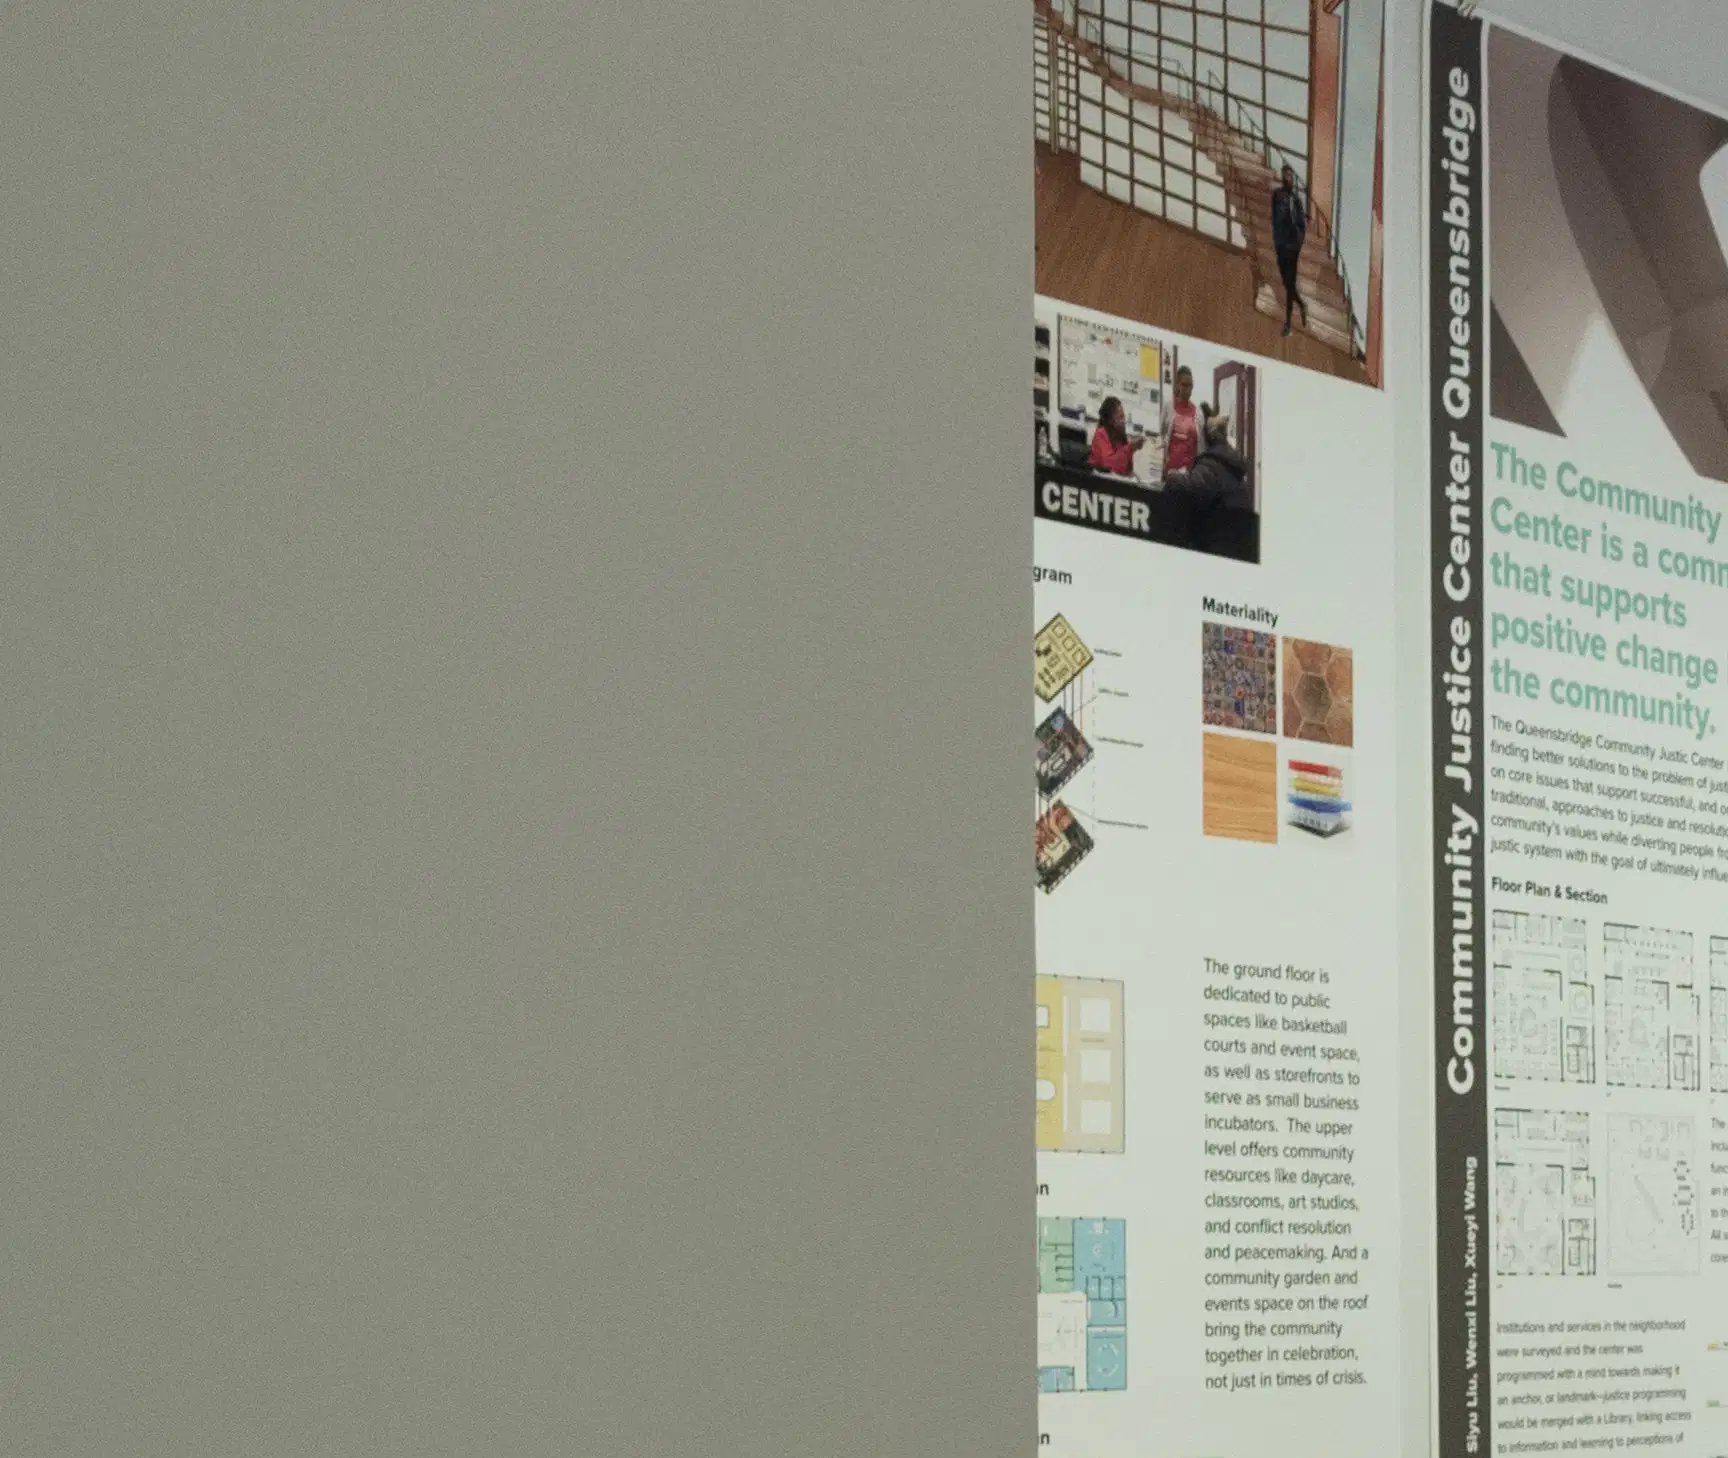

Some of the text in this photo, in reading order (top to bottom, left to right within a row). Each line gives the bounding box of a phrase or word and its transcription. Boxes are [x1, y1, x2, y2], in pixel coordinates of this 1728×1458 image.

[1489, 442, 1547, 491] The
[1556, 461, 1723, 545] Community
[1042, 481, 1150, 533] CENTER
[1490, 496, 1593, 555] Center
[1601, 522, 1624, 562] is
[1632, 540, 1649, 569] a
[1442, 68, 1479, 1095] Community Justice Center Queensbridge
[1489, 551, 1688, 628] that supports
[1202, 596, 1279, 628] Materiality
[1491, 611, 1607, 662] positive
[1615, 633, 1719, 690] change
[1490, 657, 1716, 741] the community.
[1491, 875, 1522, 894] Floor
[1525, 880, 1551, 897] Plan
[1565, 885, 1608, 904] Section
[1203, 957, 1330, 984] The ground floor is
[1203, 983, 1331, 1010] dedicated to public
[1203, 1012, 1348, 1036] spaces like basketball
[1203, 1038, 1247, 1054] courts
[1250, 1039, 1276, 1056] and
[1279, 1044, 1317, 1059] event
[1204, 1064, 1361, 1086] as well as storefronts to
[1204, 1091, 1360, 1111] serve as small business
[1286, 1116, 1312, 1134] The
[1315, 1122, 1353, 1138] upper
[1204, 1139, 1355, 1164] level offers community
[1204, 1169, 1271, 1184] resources
[1274, 1167, 1298, 1184] like
[1464, 1156, 1478, 1211] Wang
[1288, 1195, 1307, 1210] art
[1204, 1218, 1352, 1235] and conflict resolution
[1204, 1243, 1231, 1260] and
[1331, 1244, 1358, 1260] And
[1361, 1248, 1369, 1260] a
[1204, 1269, 1358, 1290] community garden and
[1204, 1294, 1369, 1315] events space on the roof
[1205, 1320, 1343, 1342] bring the community
[1204, 1347, 1263, 1368] together
[1267, 1346, 1279, 1361] in
[1205, 1373, 1228, 1389] not
[1230, 1373, 1256, 1393] just
[1259, 1372, 1272, 1389] in
[1275, 1372, 1313, 1387] times
[1315, 1369, 1330, 1386] of
